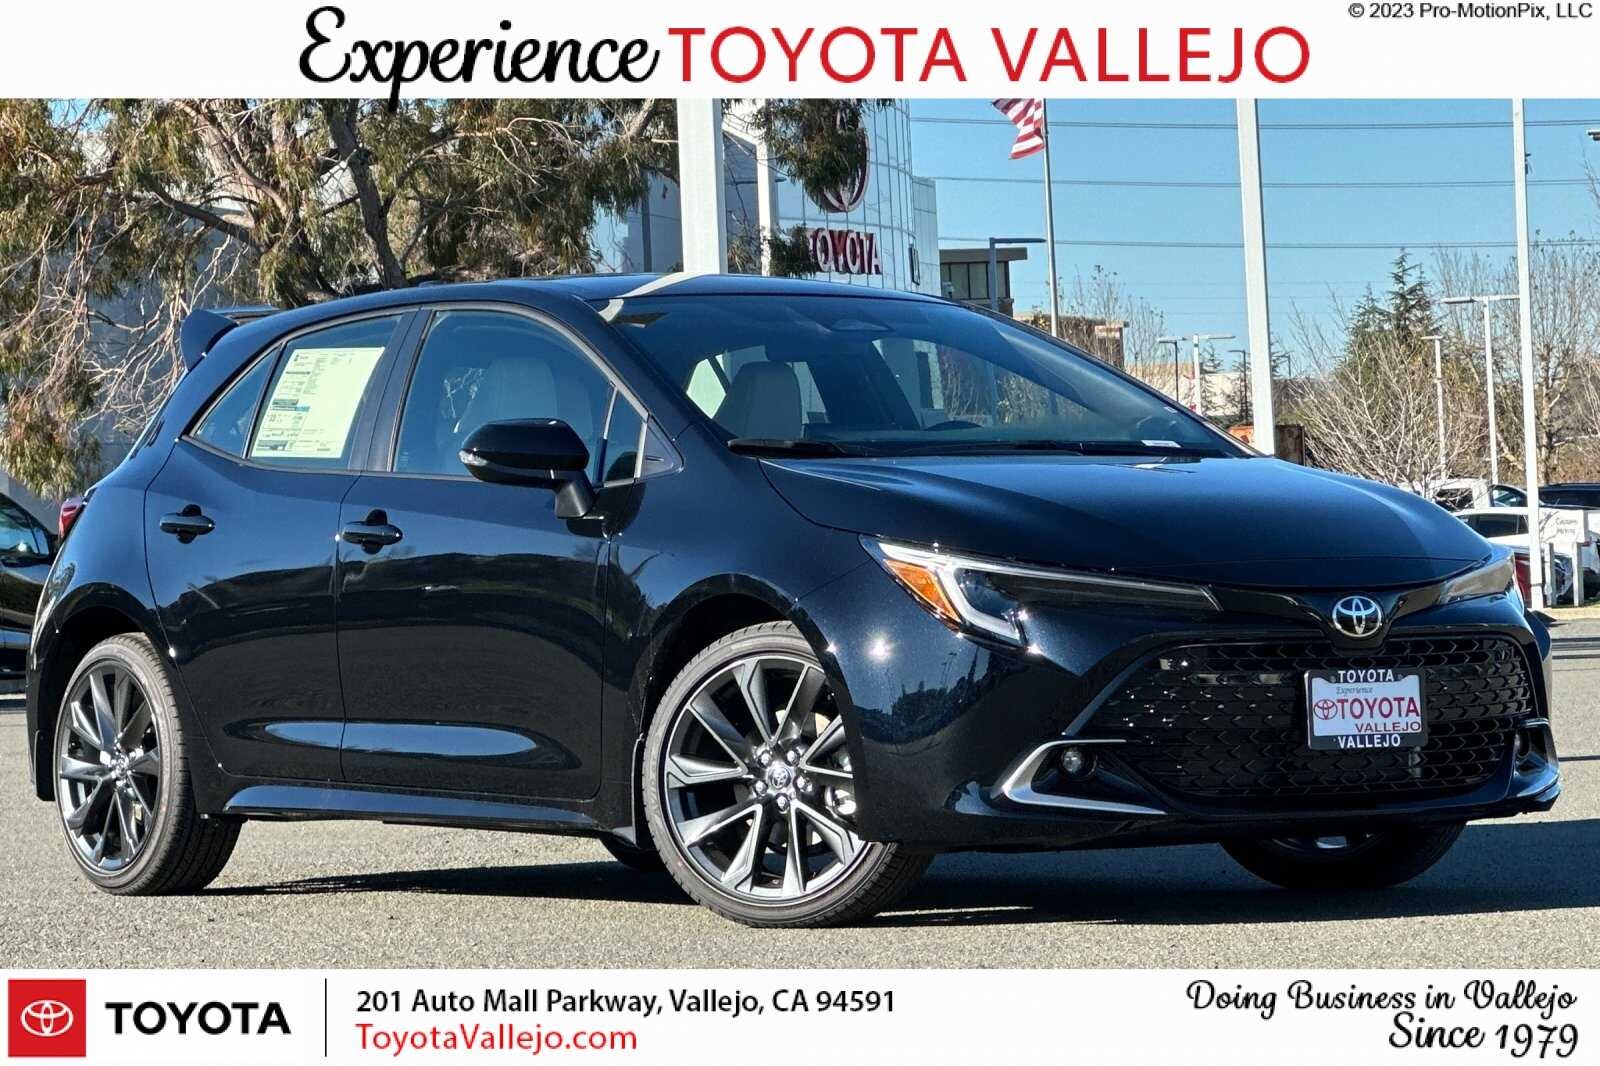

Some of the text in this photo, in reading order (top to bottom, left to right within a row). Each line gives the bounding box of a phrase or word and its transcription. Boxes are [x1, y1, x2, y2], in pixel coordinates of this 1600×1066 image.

[806, 228, 882, 274] TOYOTA
[1337, 670, 1394, 682] TOYOTA
[1336, 686, 1373, 696] Experience
[1337, 697, 1419, 718] TOYOTA
[1355, 721, 1421, 732] VALLEJO
[1337, 734, 1400, 748] VALLEJO
